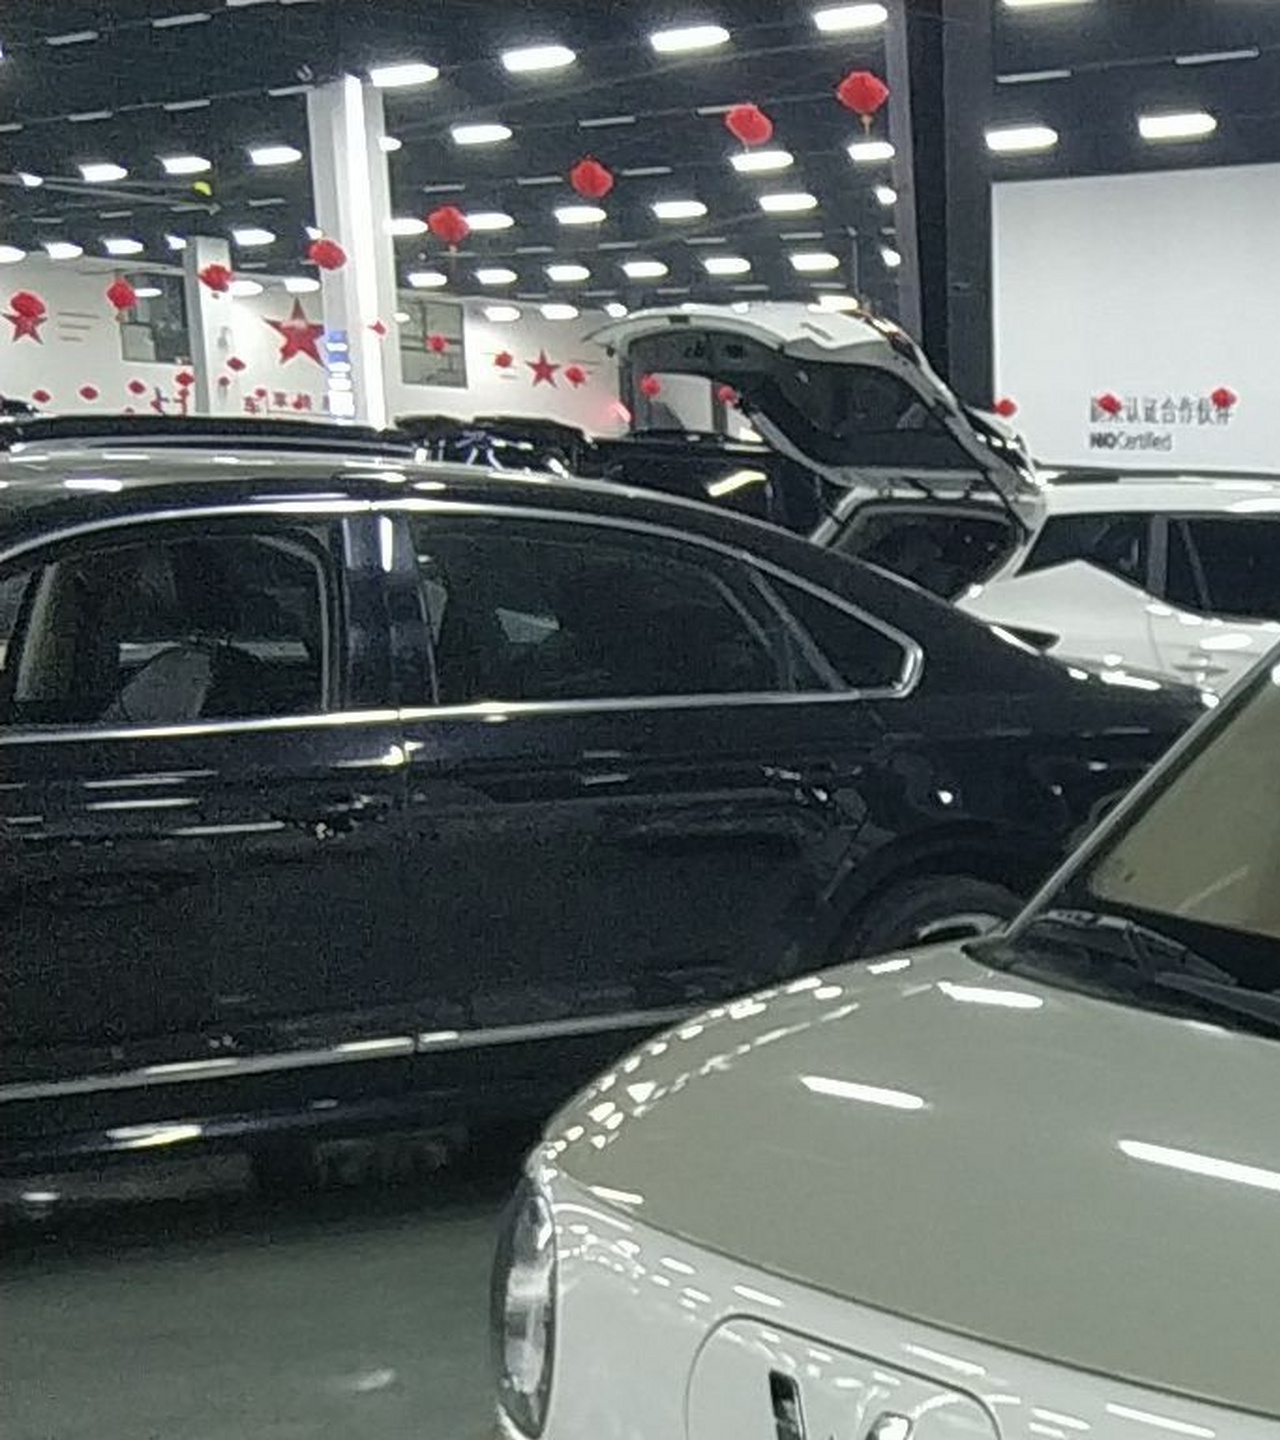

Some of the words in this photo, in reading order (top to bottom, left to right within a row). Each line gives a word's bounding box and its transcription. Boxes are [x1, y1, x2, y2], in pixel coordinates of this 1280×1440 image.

[1090, 397, 1232, 425] 认证合作伙伴
